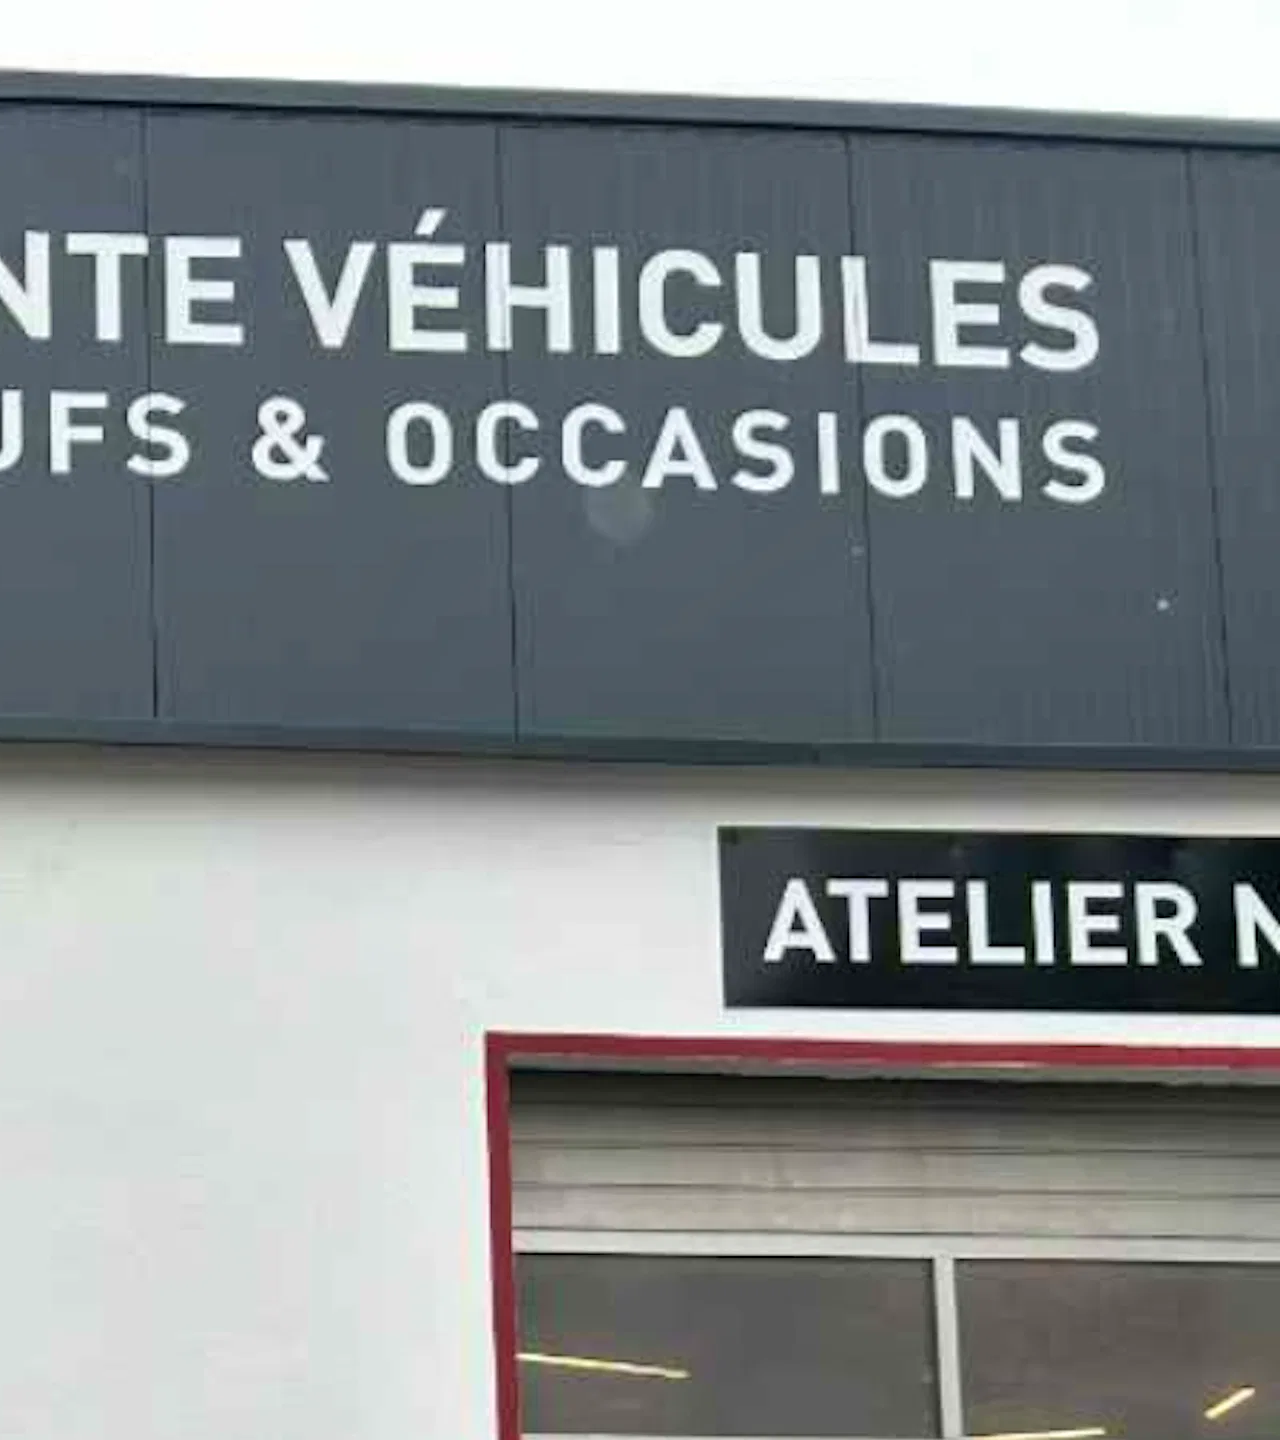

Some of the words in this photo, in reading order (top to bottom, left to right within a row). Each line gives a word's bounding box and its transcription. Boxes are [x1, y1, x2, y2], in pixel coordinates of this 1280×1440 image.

[282, 209, 1100, 371] VÉHICULES
[250, 397, 329, 481] &
[386, 400, 1106, 503] OCCASIONS
[762, 878, 1203, 967] ATELIER
